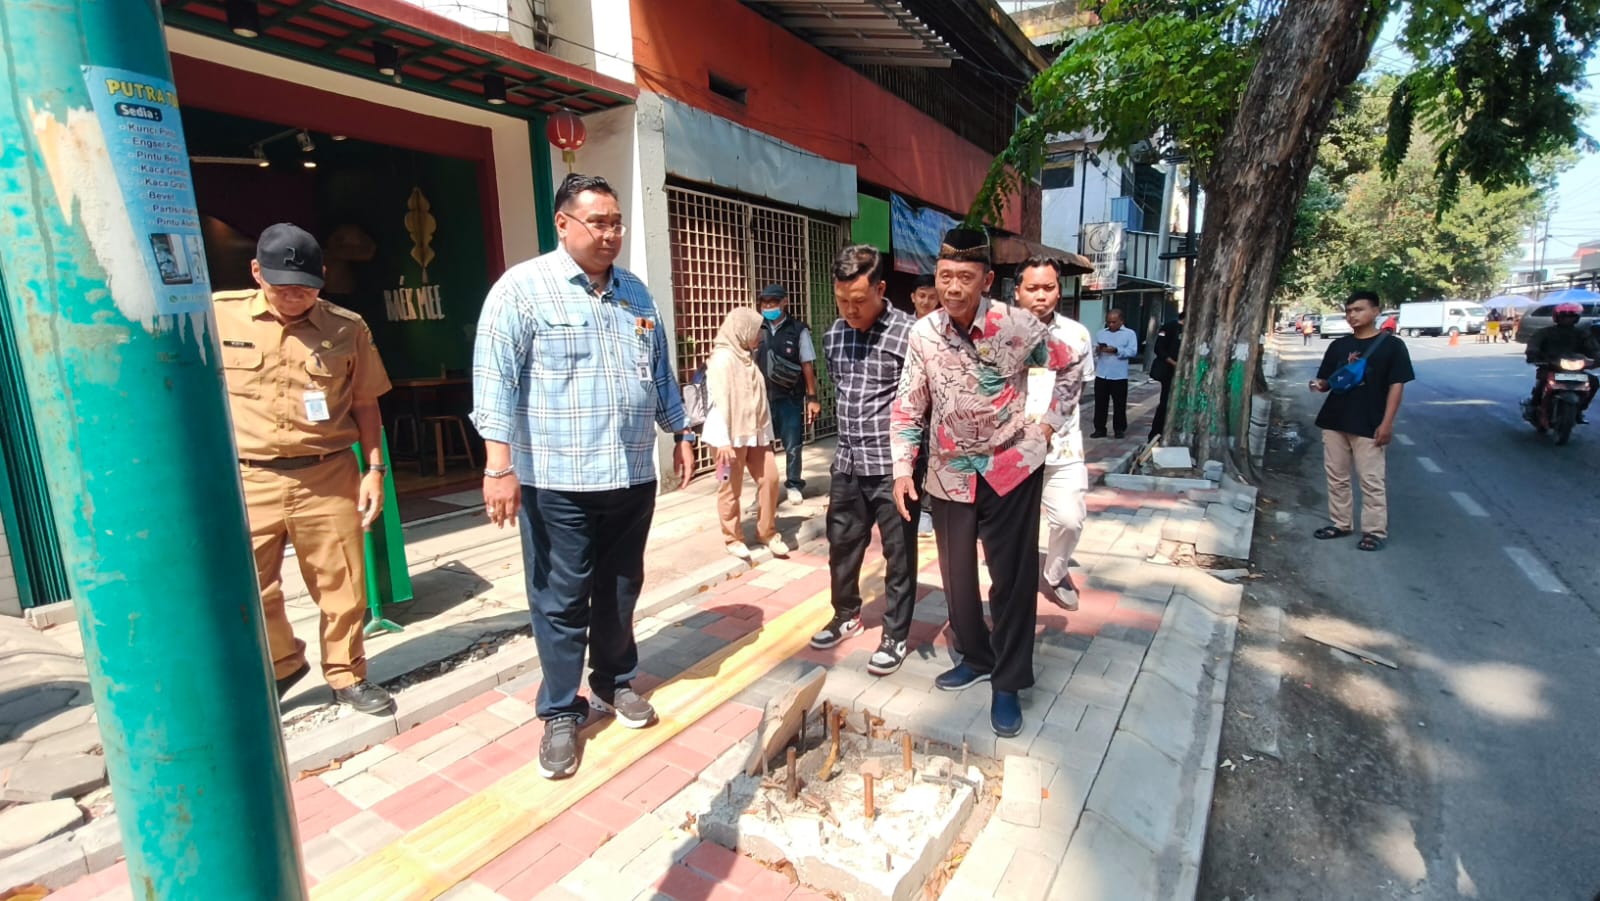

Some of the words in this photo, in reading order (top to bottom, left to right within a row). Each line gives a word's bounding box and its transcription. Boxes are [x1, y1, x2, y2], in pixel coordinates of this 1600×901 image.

[105, 79, 164, 103] PUTRA
[128, 123, 157, 134] Kunci
[136, 151, 162, 161] Pintu
[141, 165, 164, 174] Kaca
[145, 179, 168, 188] Kaca
